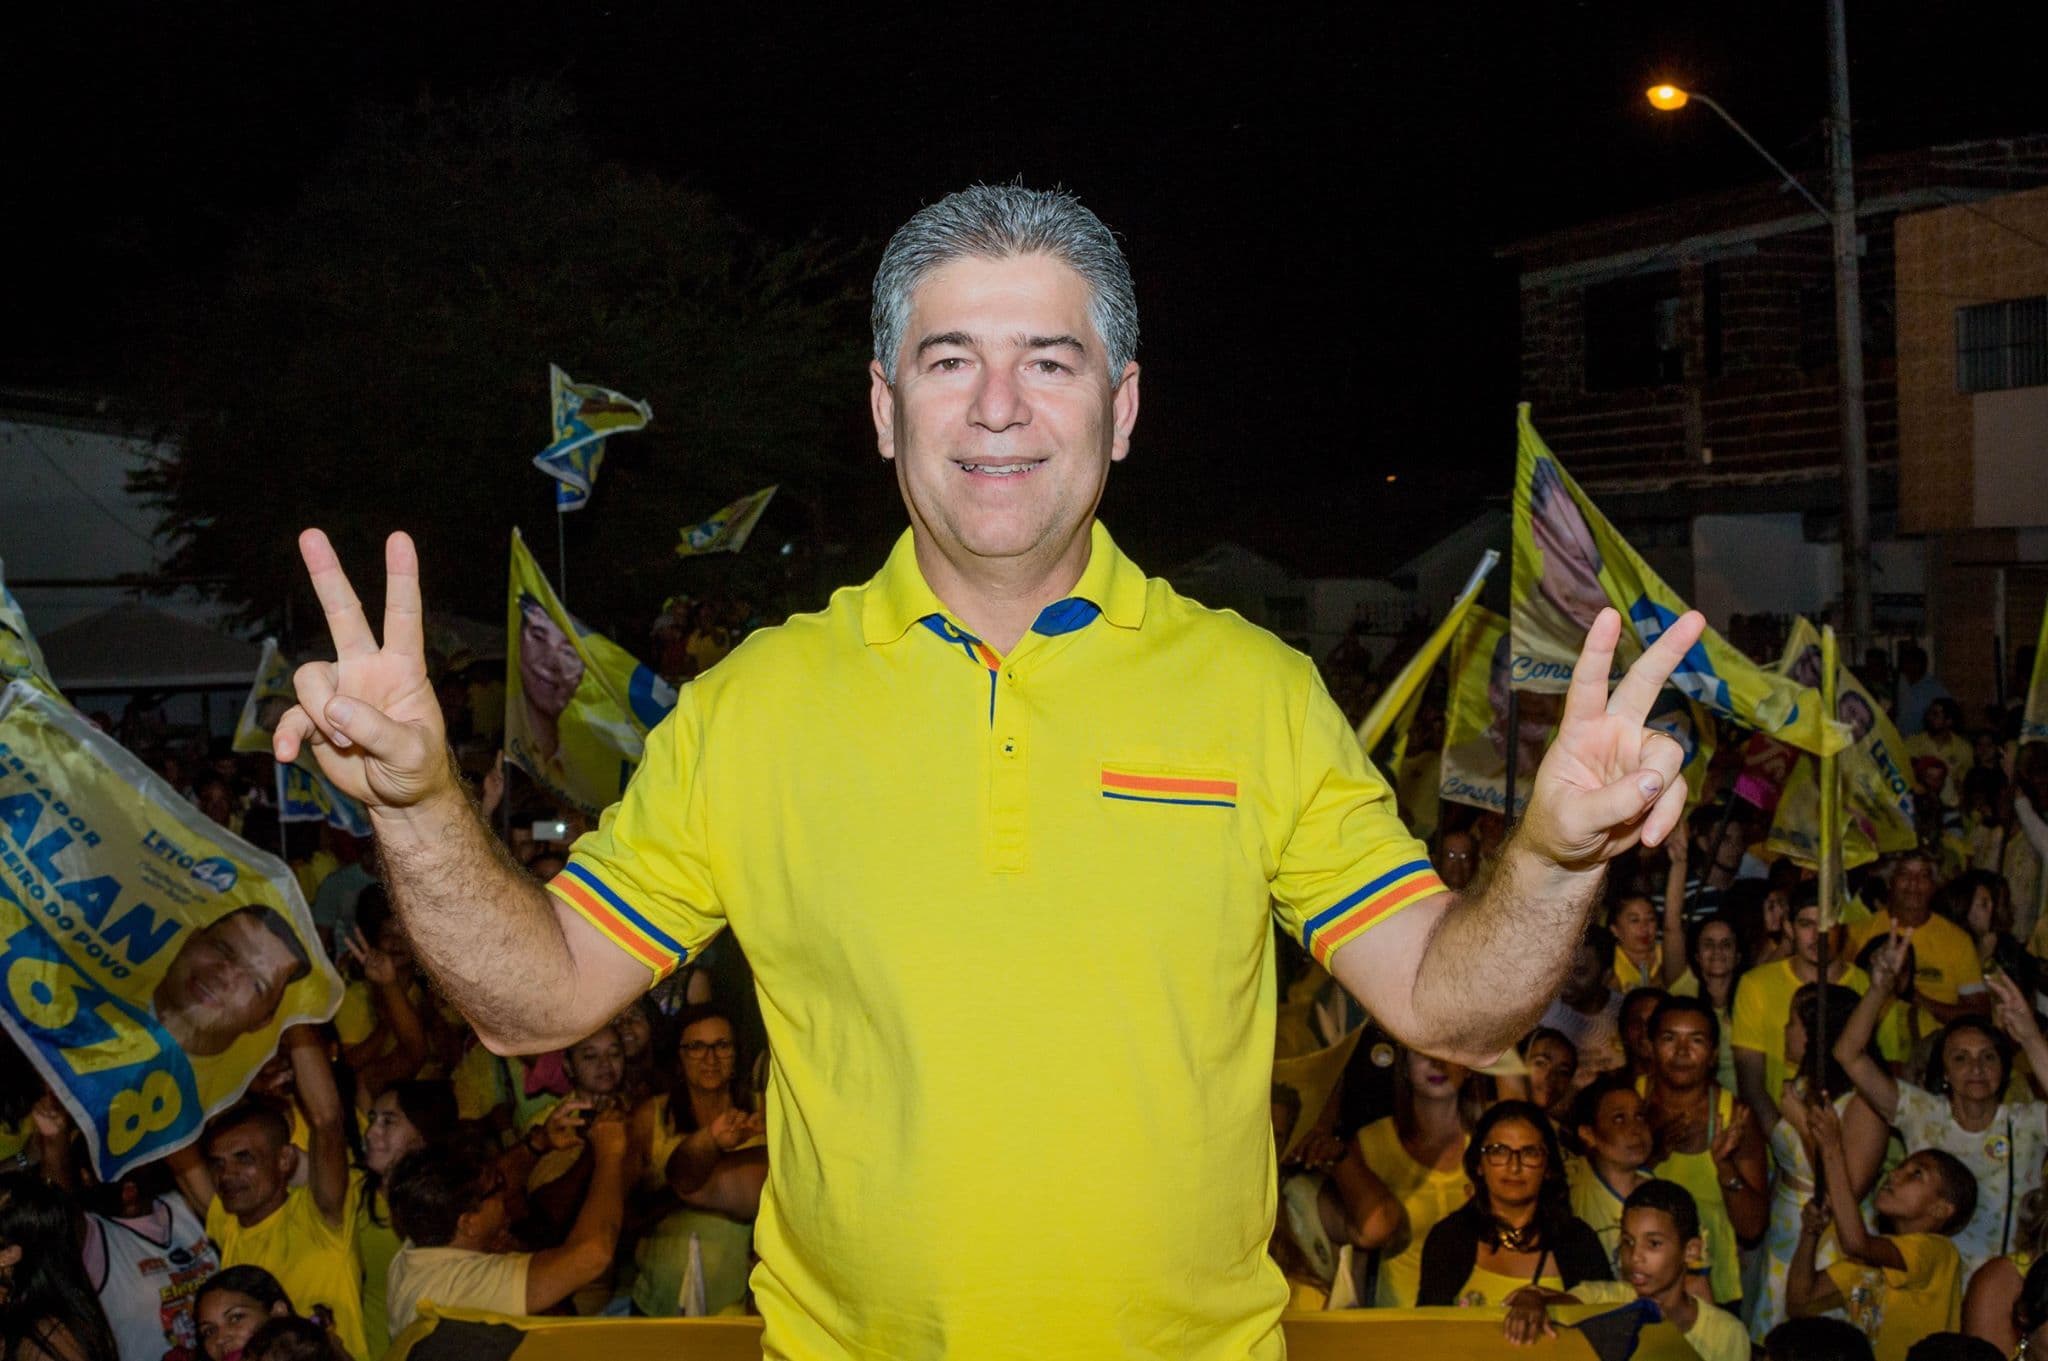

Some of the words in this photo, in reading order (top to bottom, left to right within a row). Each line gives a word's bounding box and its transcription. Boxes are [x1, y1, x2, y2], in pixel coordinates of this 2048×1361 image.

[0, 763, 182, 964] ALAN
[143, 829, 193, 869] LETO
[44, 902, 73, 930] DO
[73, 932, 130, 978] POVO
